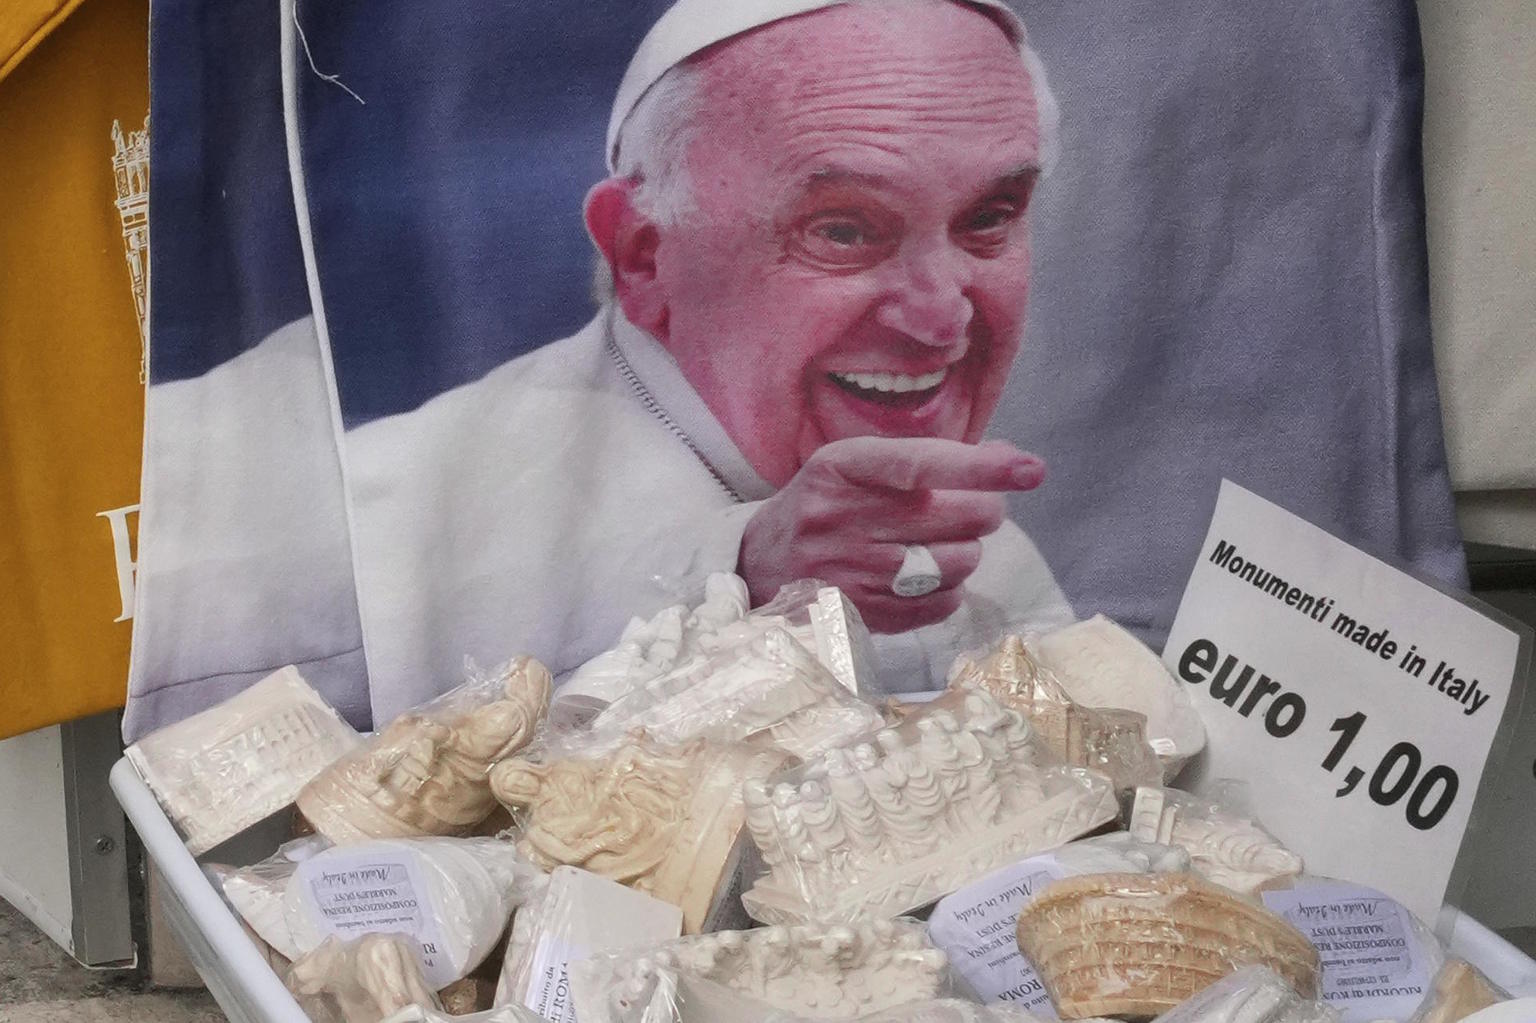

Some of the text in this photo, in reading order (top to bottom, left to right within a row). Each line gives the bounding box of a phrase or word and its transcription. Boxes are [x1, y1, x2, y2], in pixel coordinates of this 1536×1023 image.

[1208, 538, 1492, 717] Monumenti made in Italy
[1177, 638, 1460, 831] euro 1,00
[998, 875, 1032, 902] Made
[953, 902, 985, 924] Italy
[984, 897, 997, 909] in
[1297, 901, 1377, 920] Made in Italy
[1333, 937, 1406, 950] COMPOSIZIONE
[997, 978, 1043, 1002] ROMA
